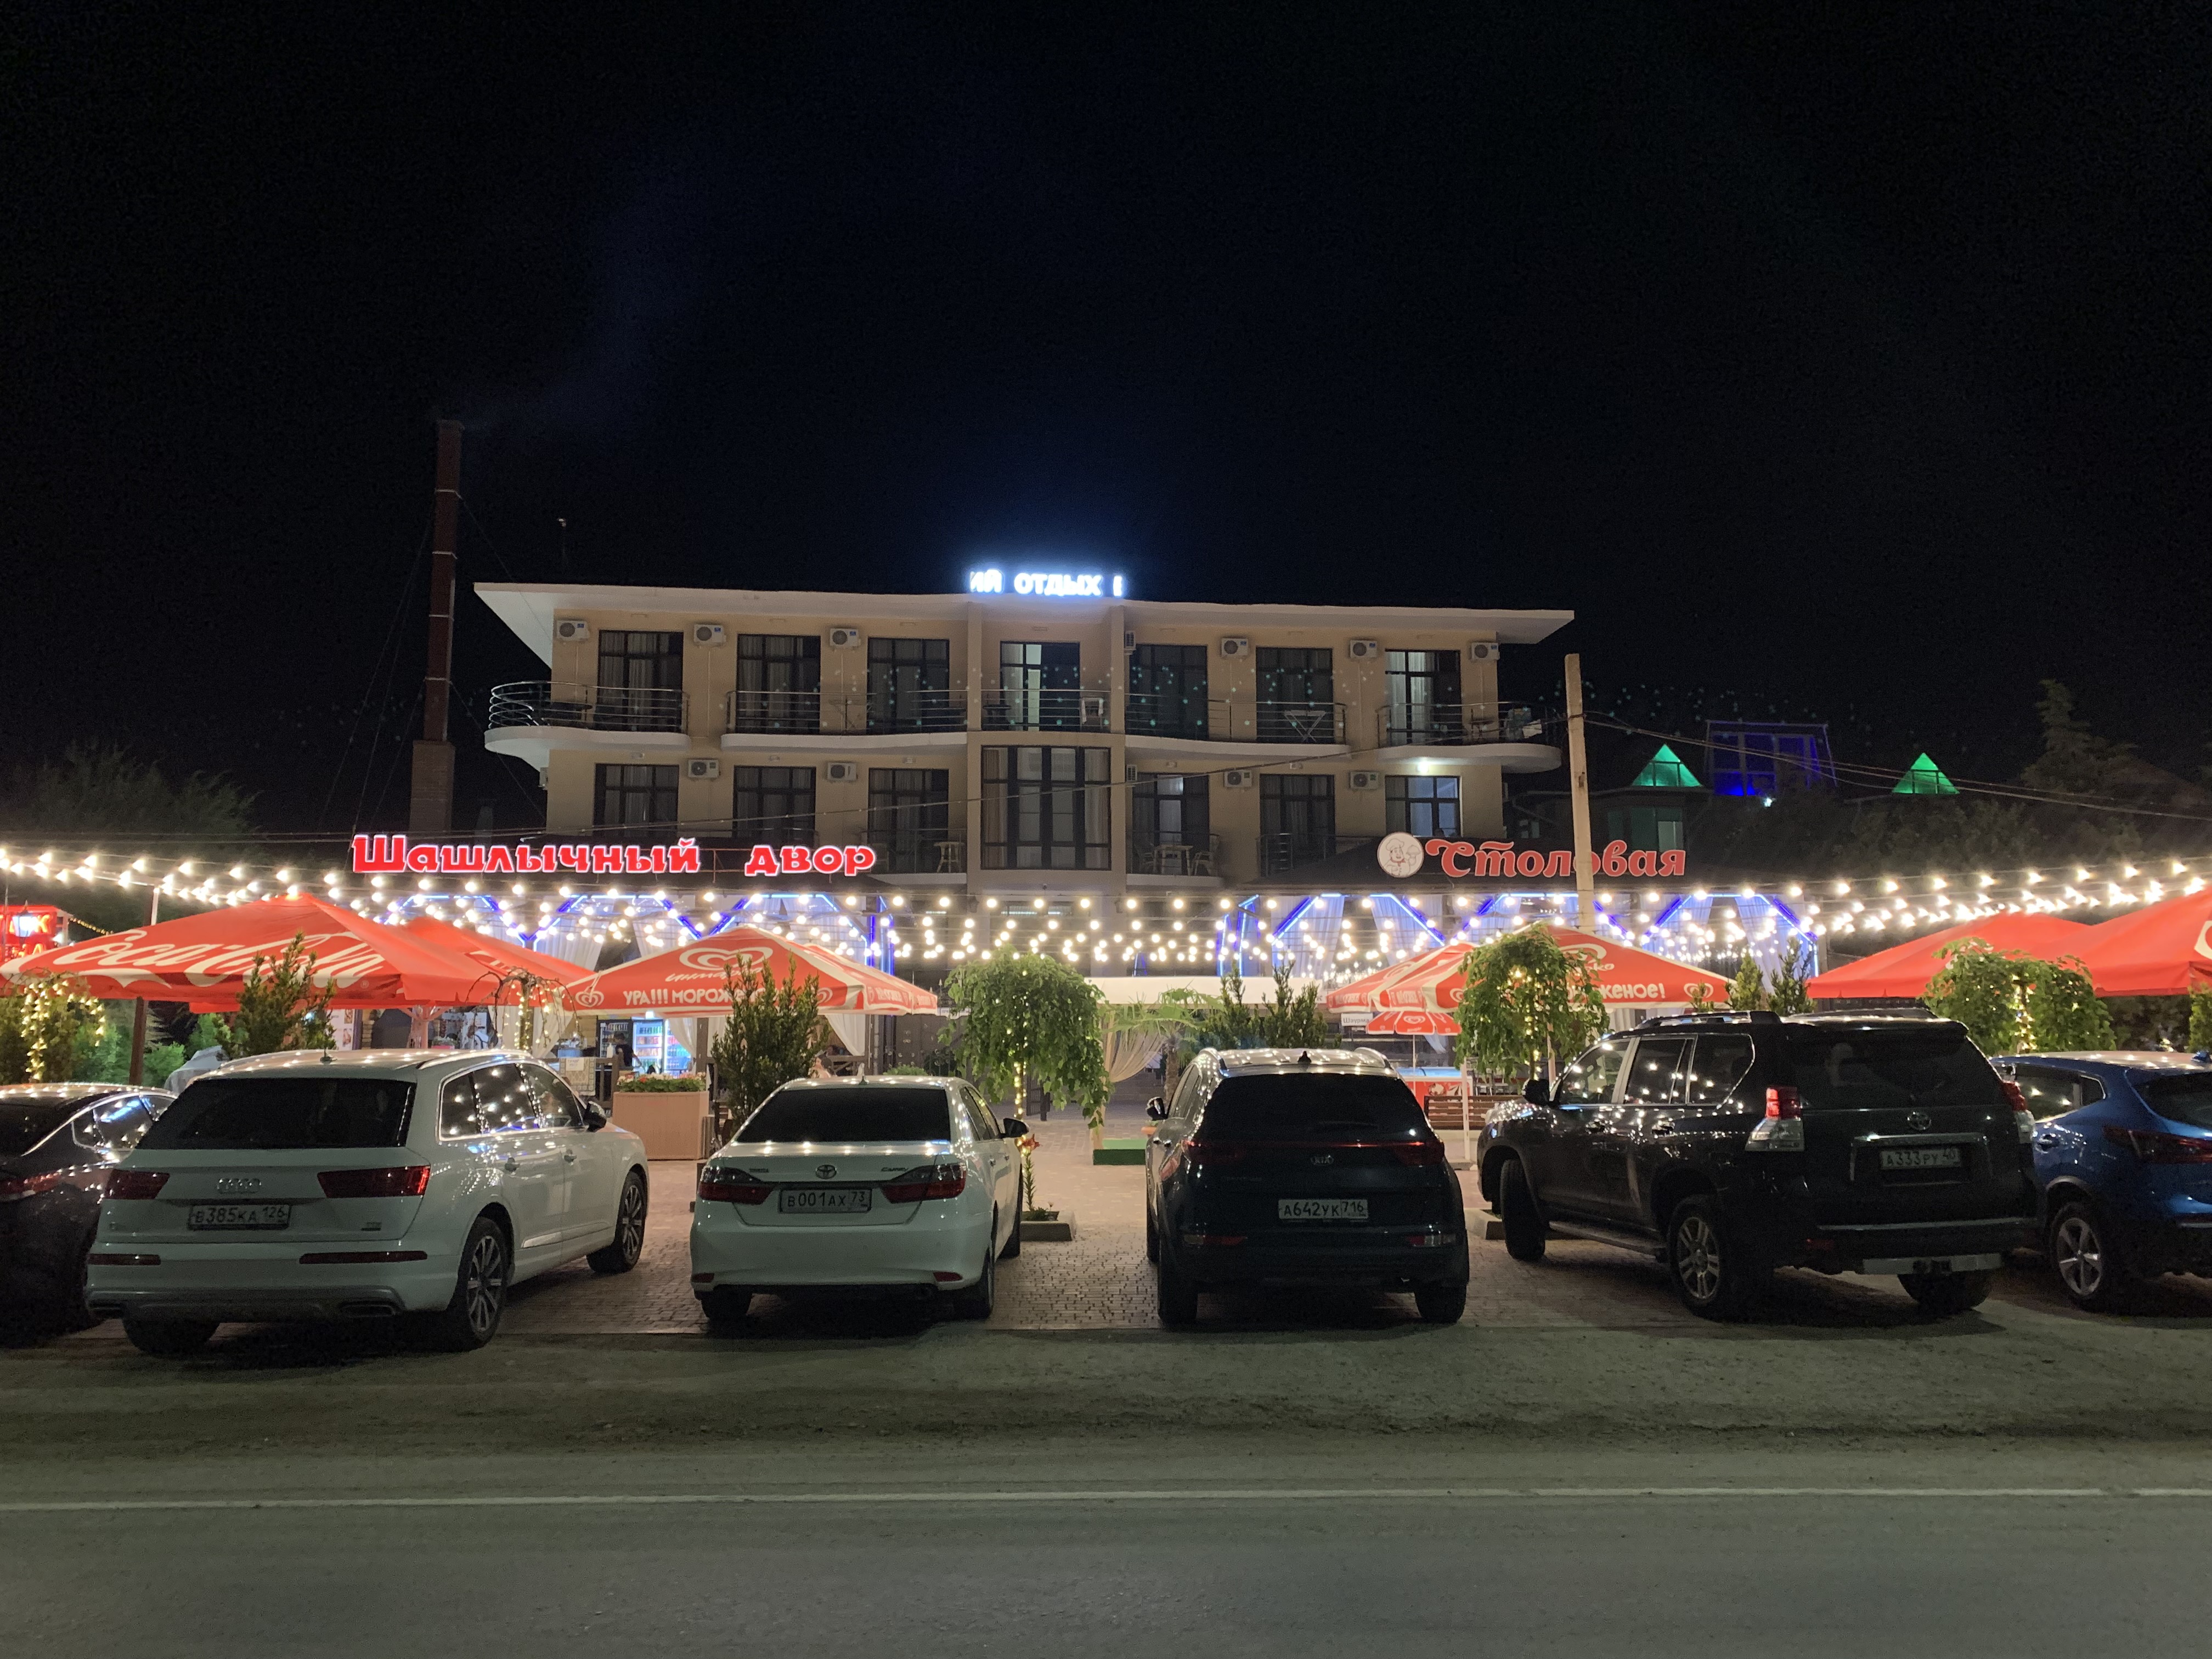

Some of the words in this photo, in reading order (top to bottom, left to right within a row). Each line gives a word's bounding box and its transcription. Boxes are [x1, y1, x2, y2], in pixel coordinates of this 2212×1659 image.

[1013, 572, 1103, 597] ОТДЫХ
[352, 834, 702, 873] Шашлычный
[623, 989, 668, 1006] УРА!!!
[787, 1192, 847, 1207] В001АХ
[851, 1192, 865, 1203] 73
[195, 1207, 257, 1223] В385КА
[263, 1206, 286, 1218] 126
[1284, 1201, 1339, 1216] А642УК
[1342, 1201, 1364, 1212] 716
